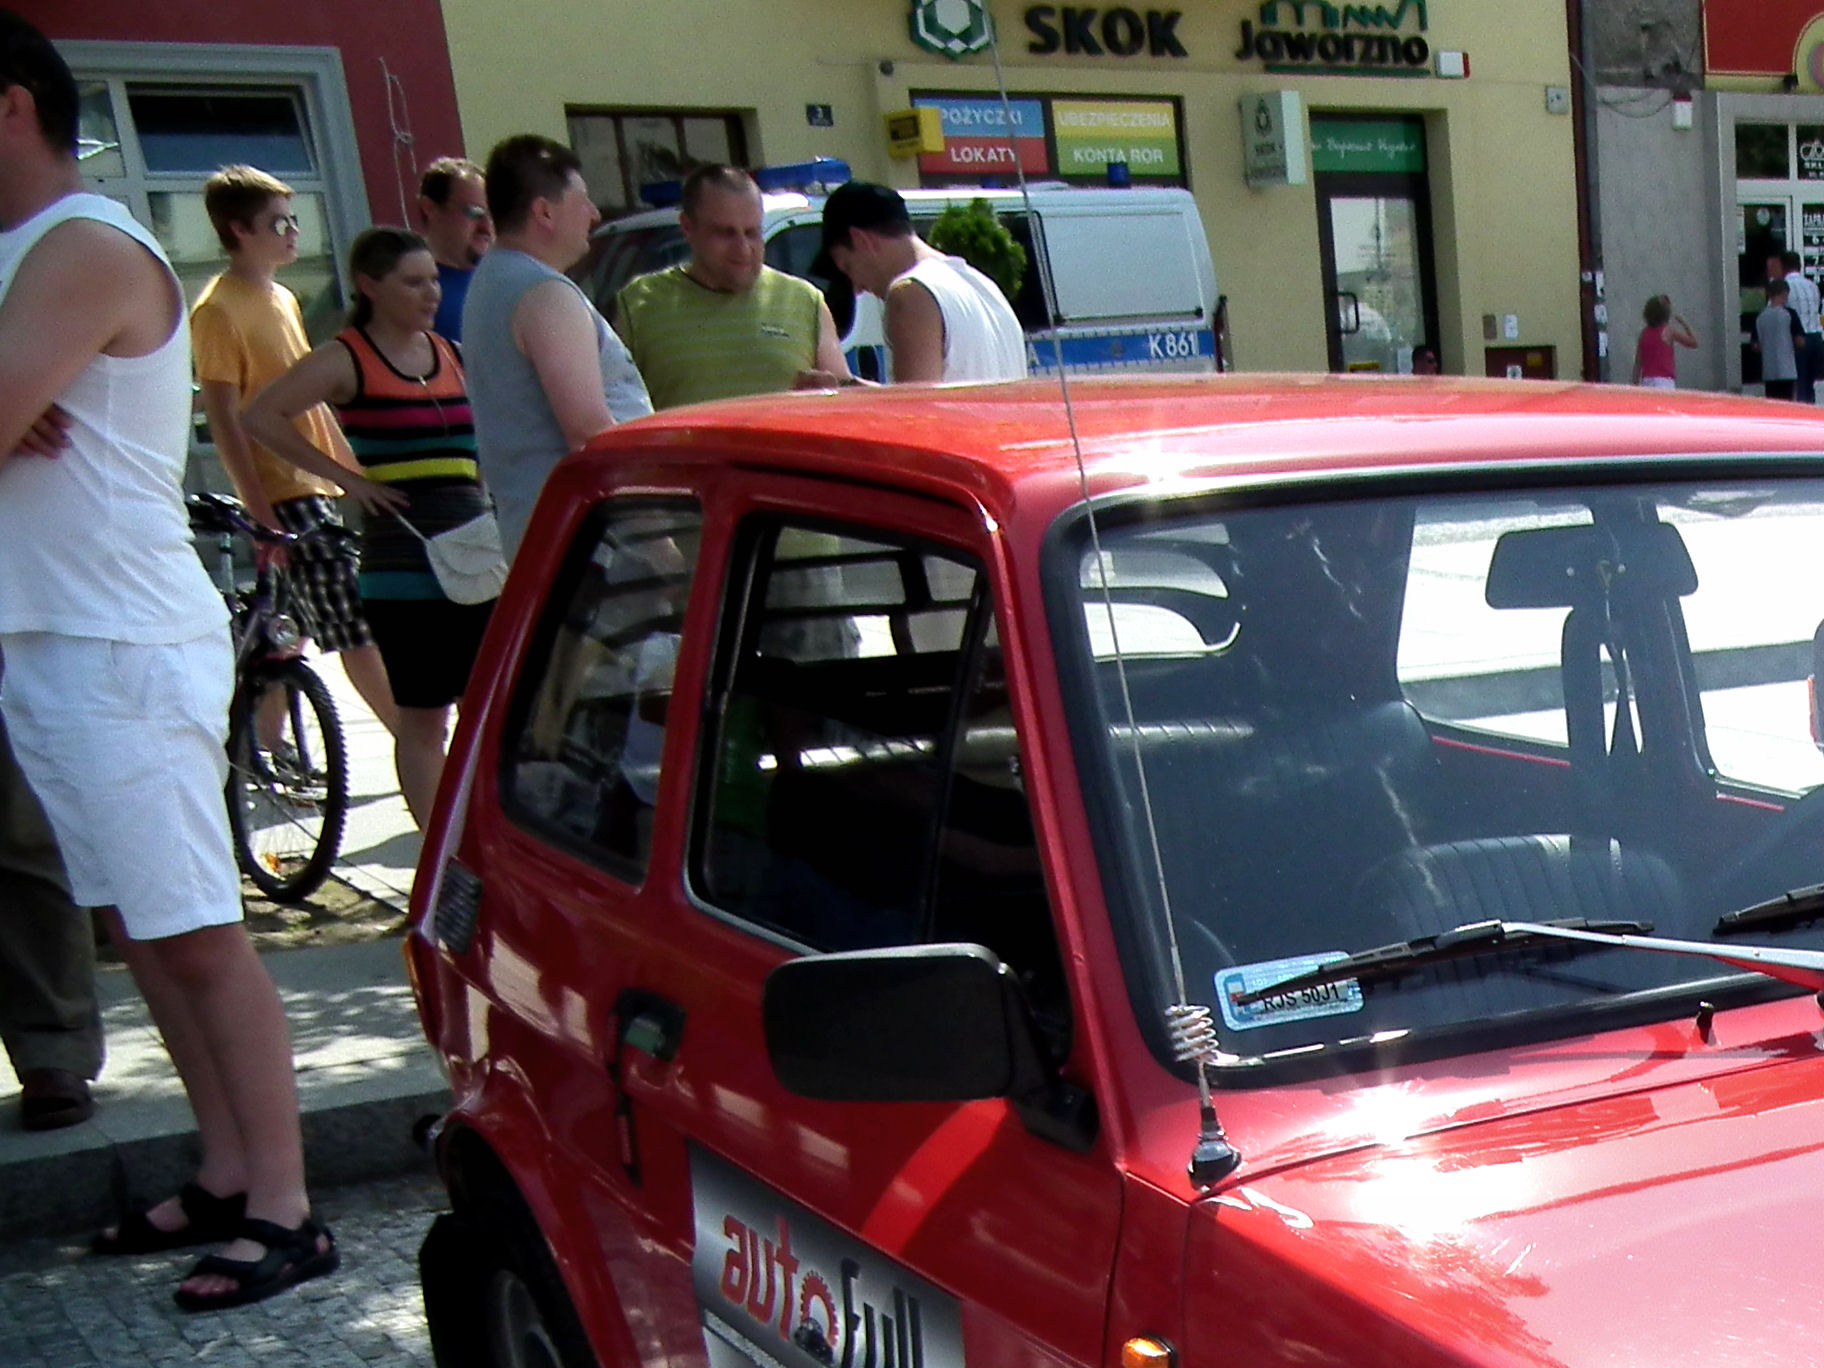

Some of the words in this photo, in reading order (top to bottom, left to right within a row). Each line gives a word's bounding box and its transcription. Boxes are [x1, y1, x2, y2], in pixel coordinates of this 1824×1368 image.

[1025, 6, 1188, 57] SKOK
[1235, 19, 1430, 65] Jaworzno
[1059, 110, 1171, 128] UBEZPIECZENIA
[951, 147, 1017, 163] LOKATY
[1073, 147, 1125, 163] KONTA
[1130, 148, 1164, 164] ROR
[1148, 333, 1165, 358] K
[1262, 993, 1298, 1012] RJS
[1302, 984, 1340, 1004] 50J1
